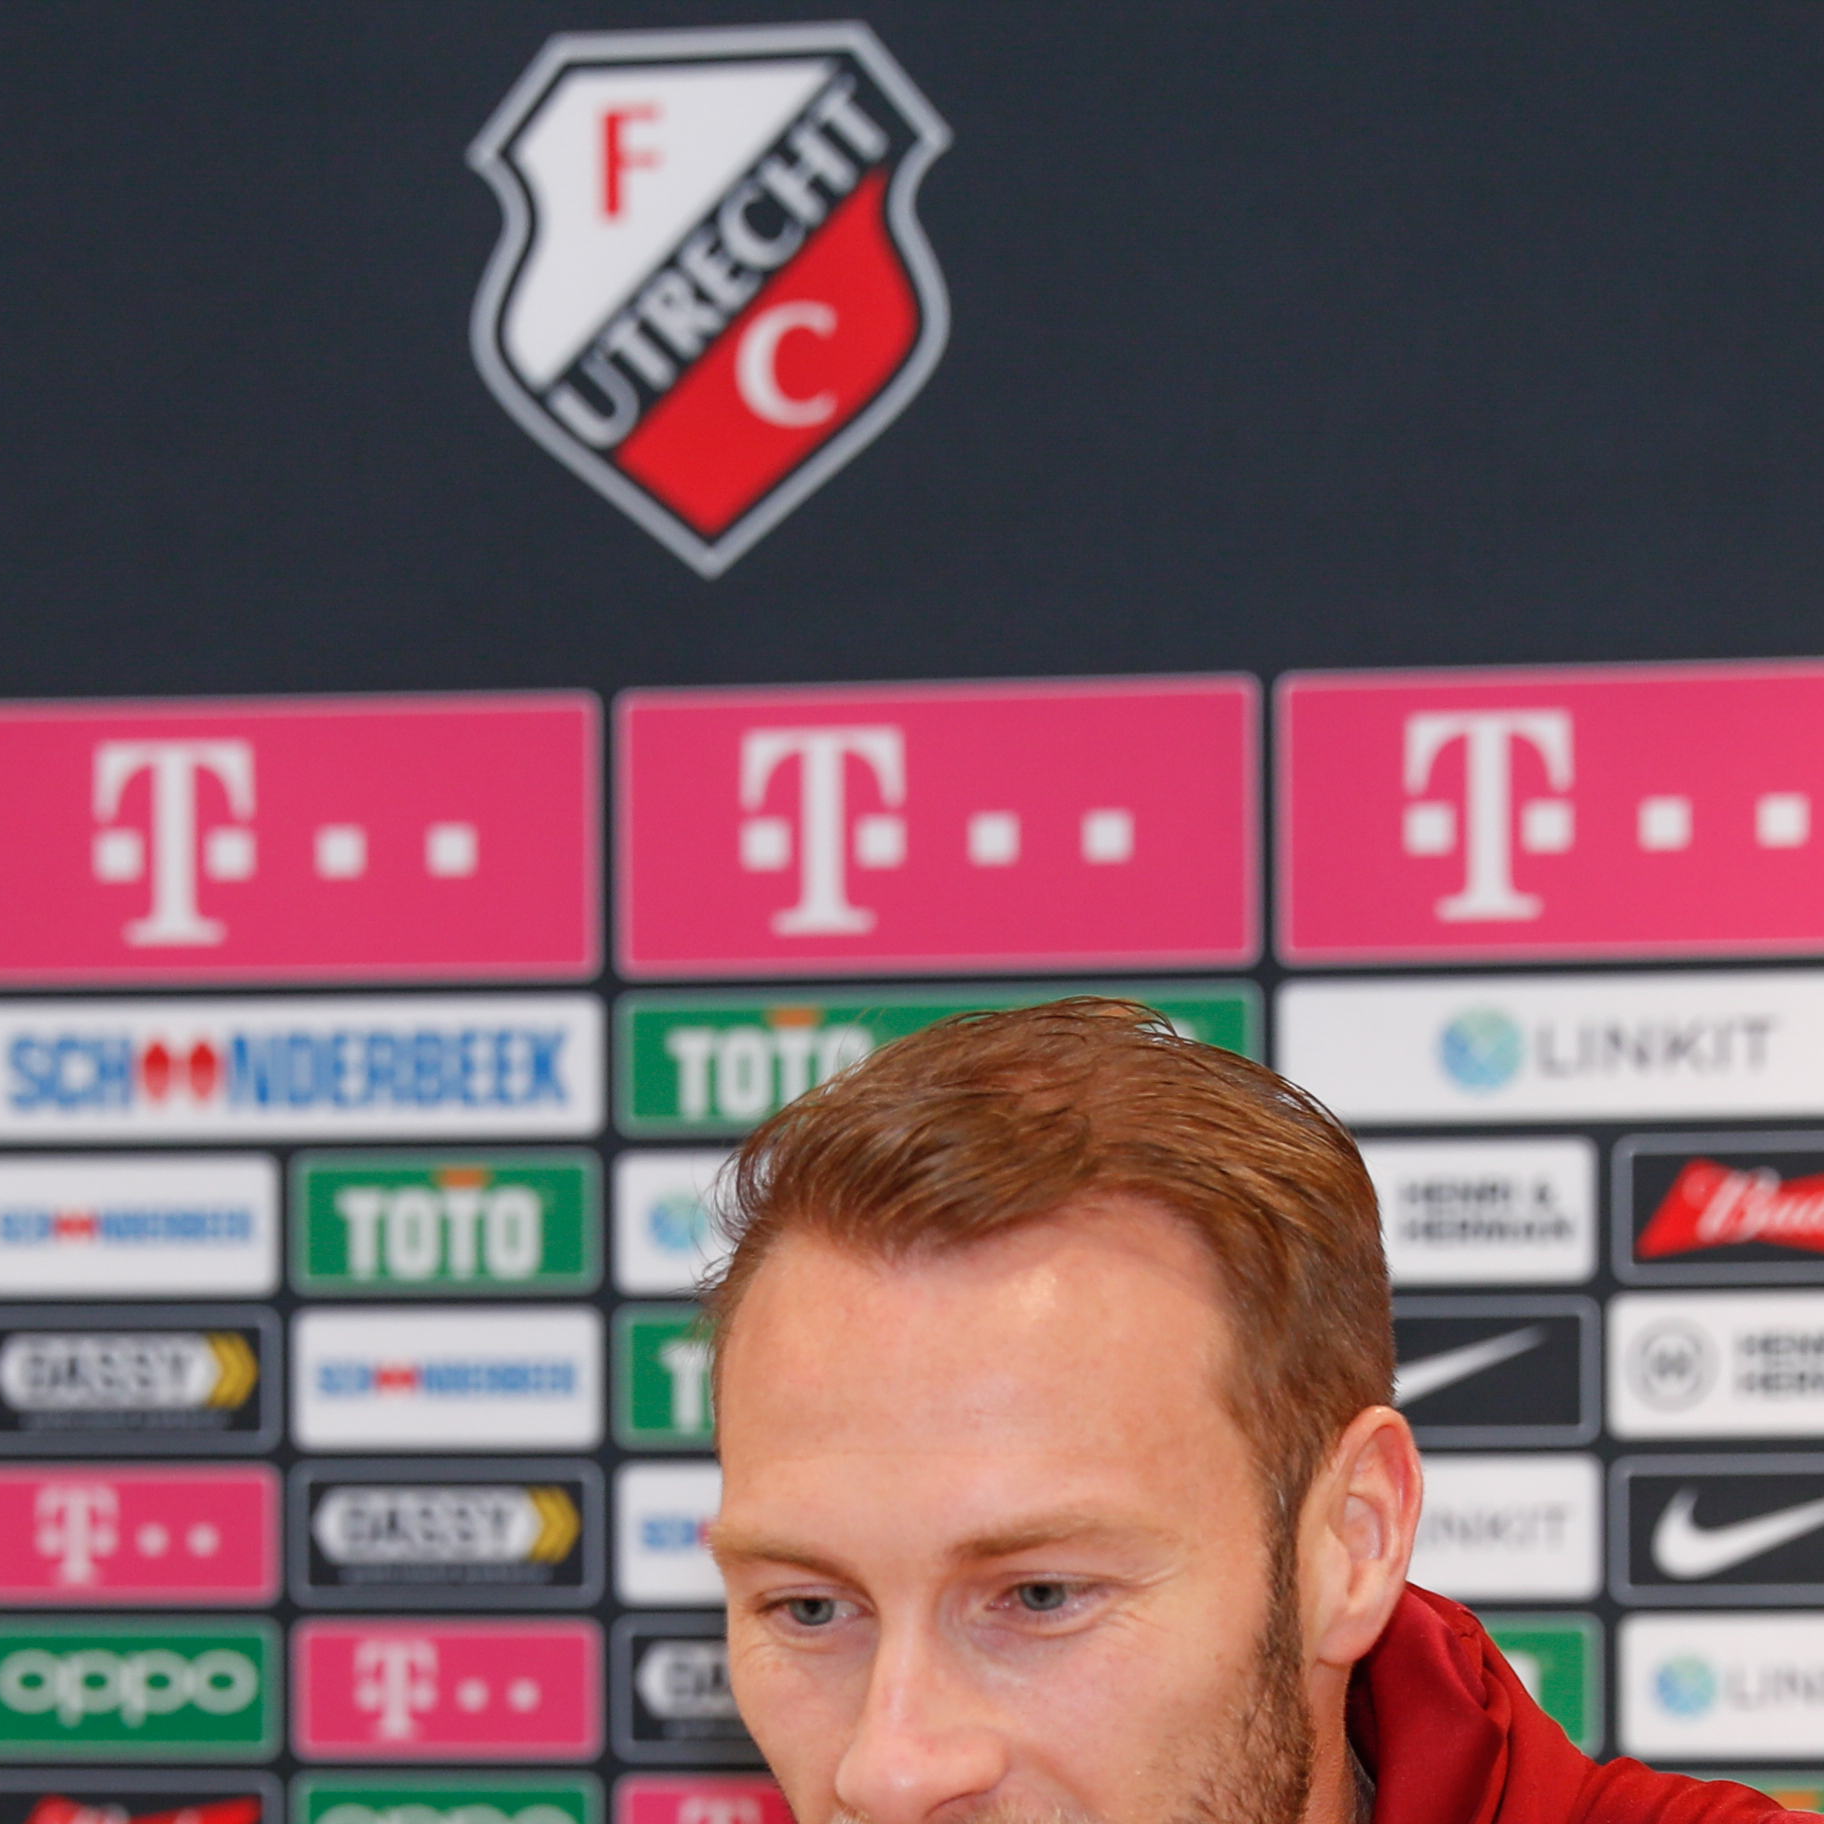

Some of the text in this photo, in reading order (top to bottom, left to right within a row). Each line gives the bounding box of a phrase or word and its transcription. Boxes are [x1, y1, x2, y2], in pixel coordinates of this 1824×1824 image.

[547, 72, 890, 452] UTRECHT
[1534, 1011, 1780, 1080] LINKIT
[334, 1184, 541, 1280] TOTO
[1421, 1503, 1575, 1551] INKIT
